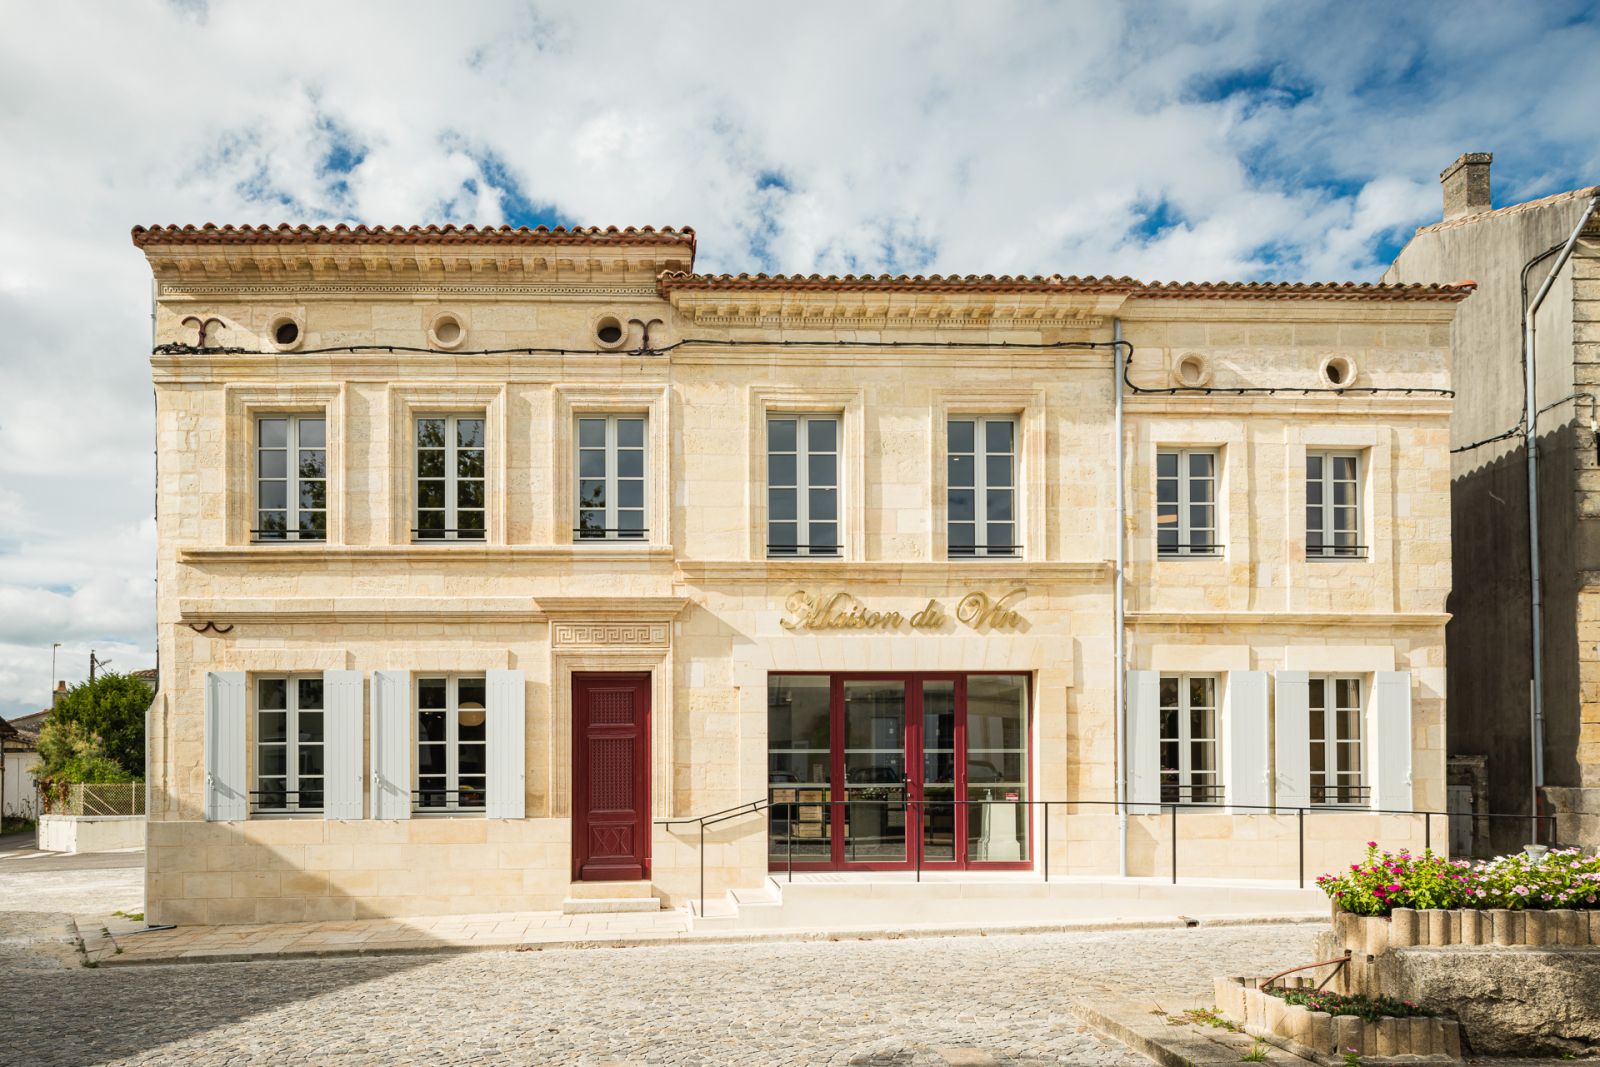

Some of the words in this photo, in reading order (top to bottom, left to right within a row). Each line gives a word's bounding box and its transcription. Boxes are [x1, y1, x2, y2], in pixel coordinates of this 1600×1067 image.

[780, 590, 904, 629] Maison
[910, 599, 945, 628] du
[956, 588, 1027, 629] Vin
